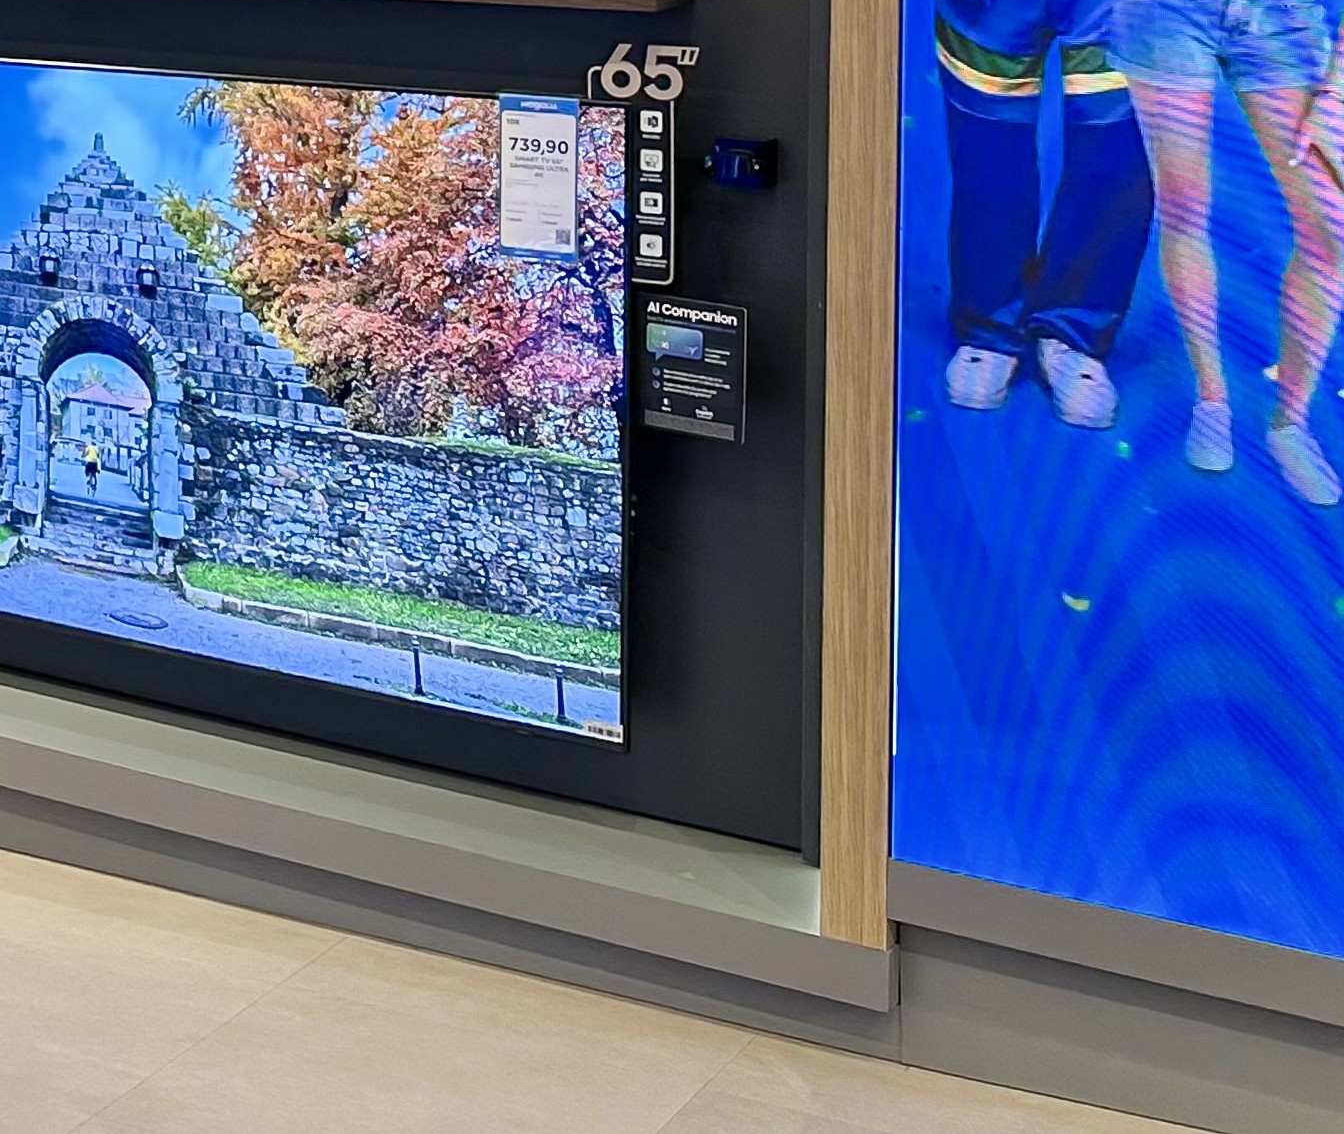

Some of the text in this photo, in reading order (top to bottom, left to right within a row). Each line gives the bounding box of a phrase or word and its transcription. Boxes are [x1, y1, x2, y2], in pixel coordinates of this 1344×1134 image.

[508, 137, 569, 156] 739,90
[647, 300, 738, 327] AI Companion
